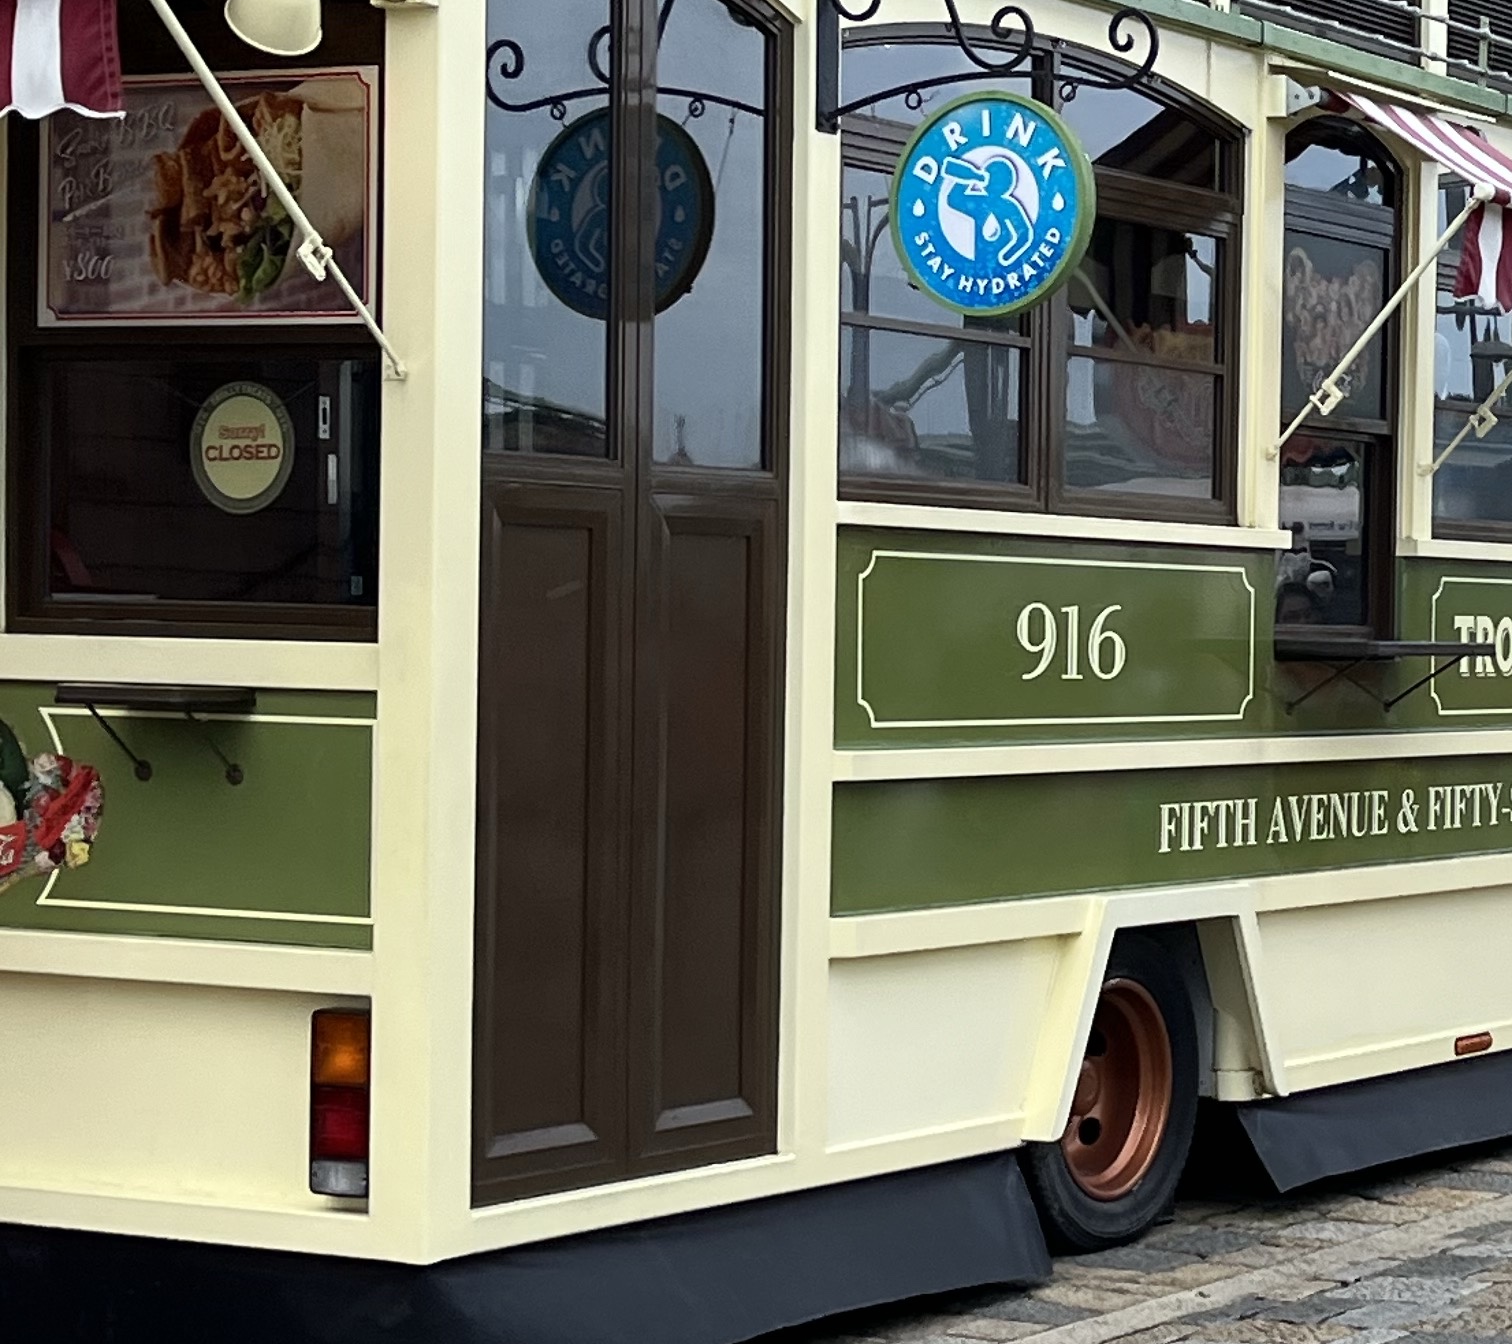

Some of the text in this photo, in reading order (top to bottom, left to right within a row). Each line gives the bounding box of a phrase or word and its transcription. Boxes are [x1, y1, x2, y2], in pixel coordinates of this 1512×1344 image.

[913, 108, 1068, 184] DRINK
[913, 226, 1062, 296] STAY HYDRATED
[205, 443, 281, 462] CLOSED
[1016, 602, 1127, 682] 916
[1158, 798, 1259, 853] FIFTH
[1266, 790, 1390, 844] AVENUE
[1397, 788, 1420, 834] &
